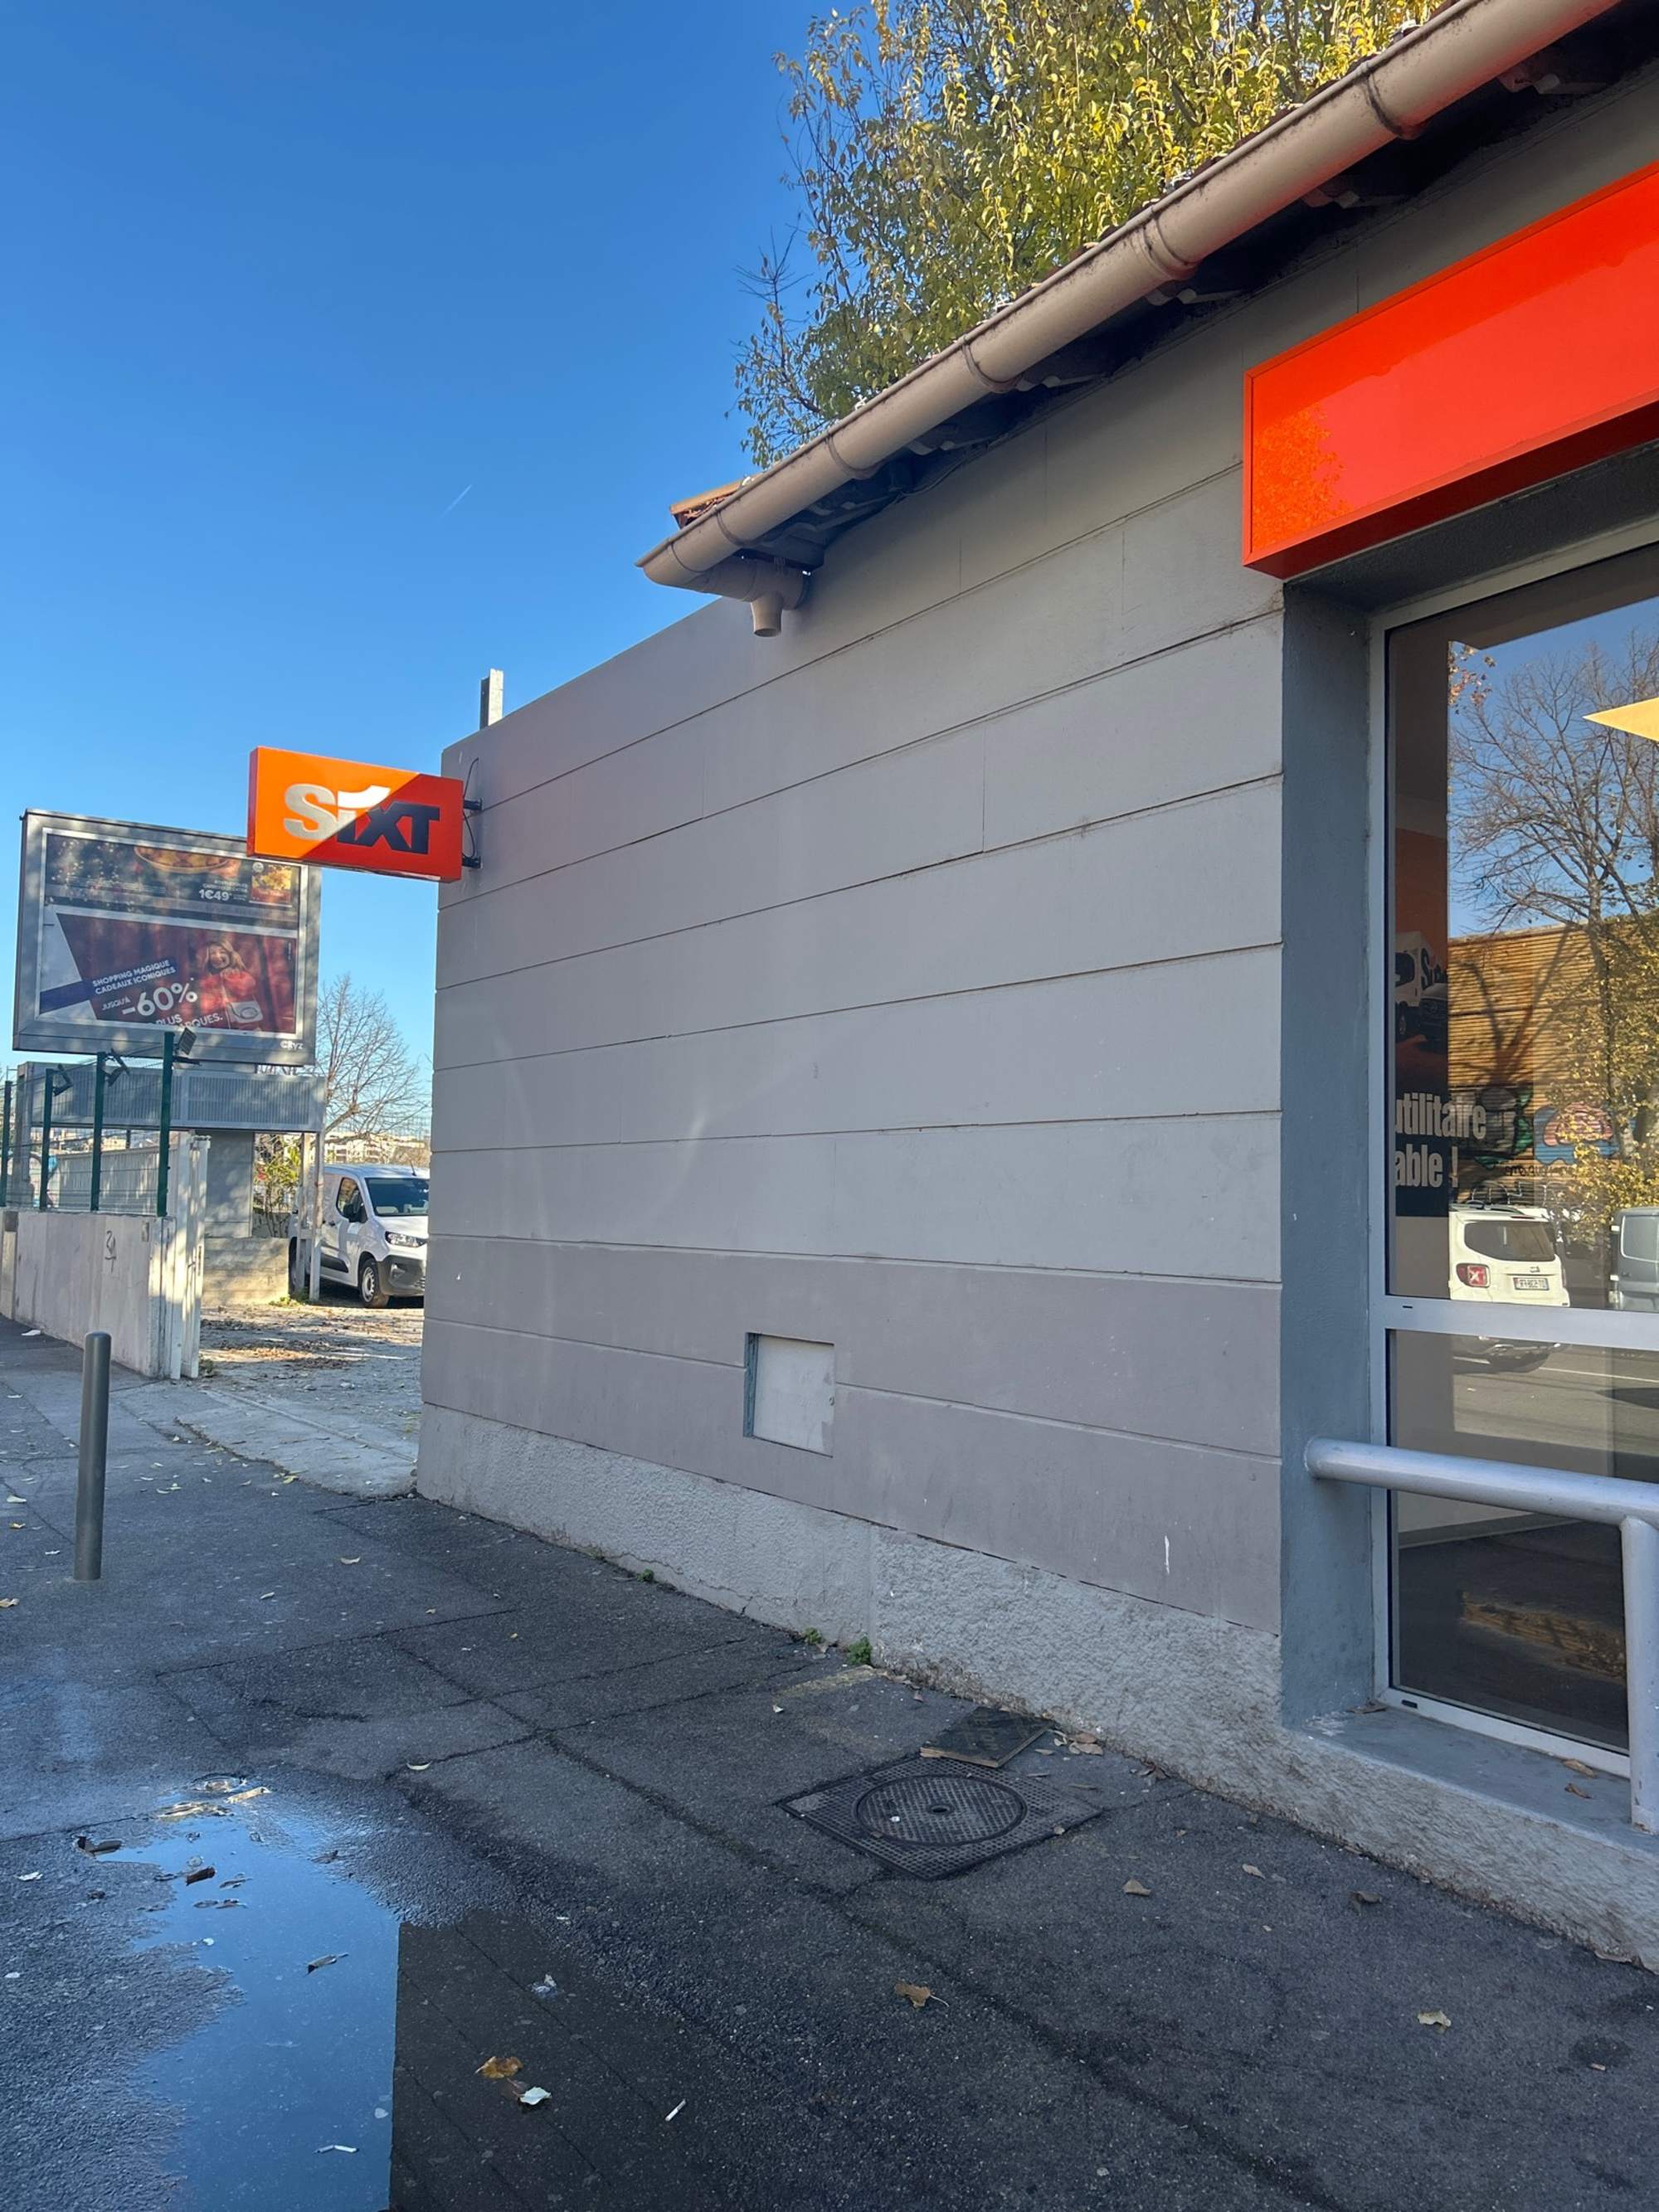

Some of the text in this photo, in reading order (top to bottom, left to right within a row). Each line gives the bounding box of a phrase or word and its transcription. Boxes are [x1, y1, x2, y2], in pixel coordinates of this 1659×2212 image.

[92, 960, 170, 987] SHOPPING MAGIQUE
[95, 966, 176, 994] CADEAUX ICONIQUES
